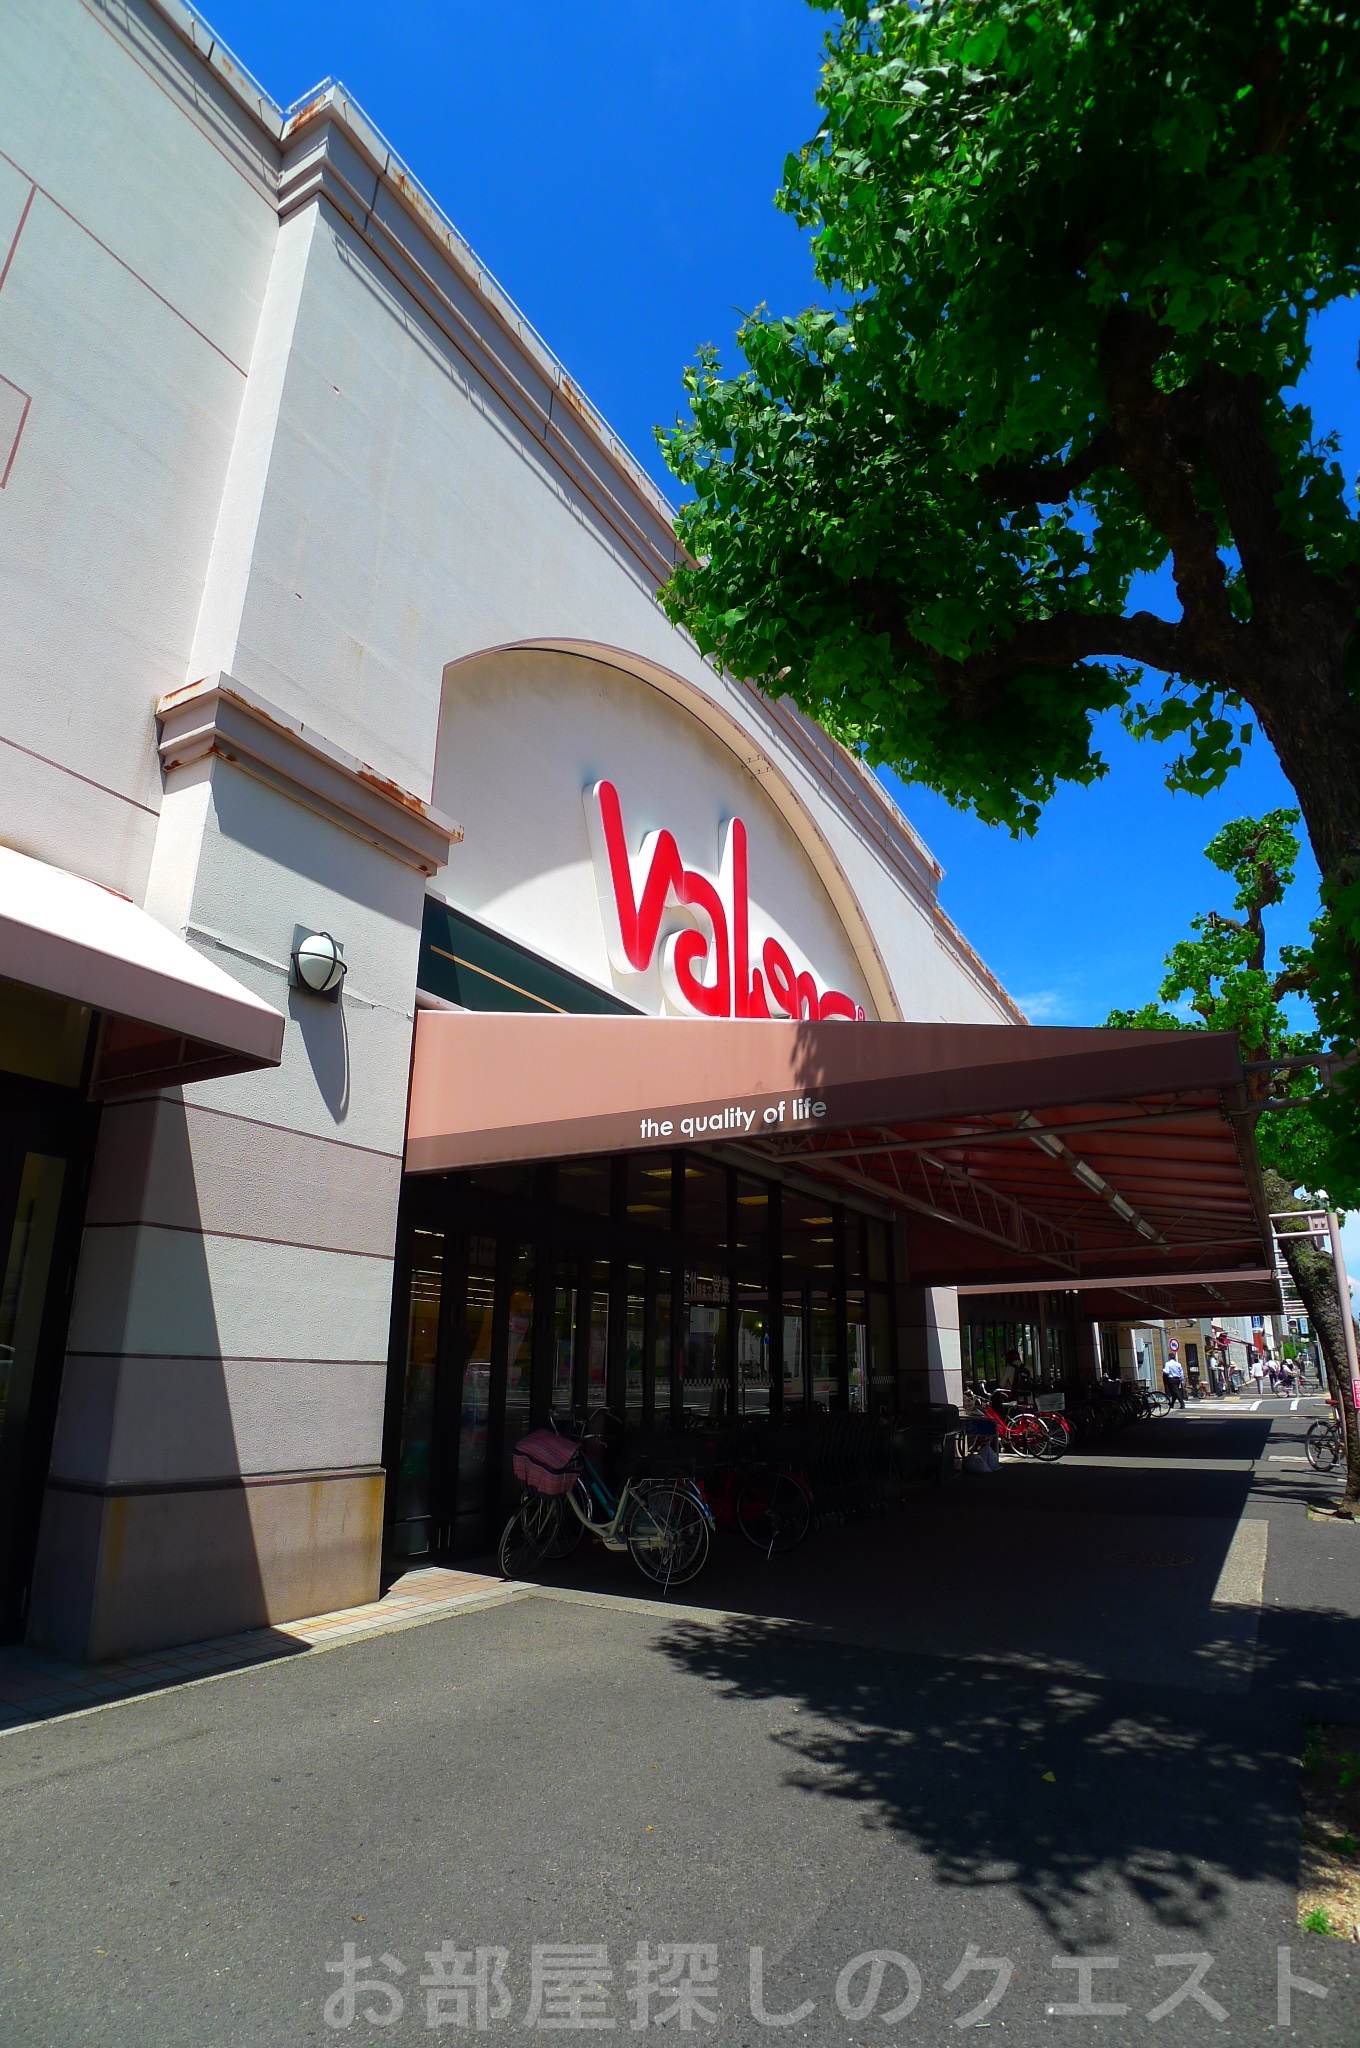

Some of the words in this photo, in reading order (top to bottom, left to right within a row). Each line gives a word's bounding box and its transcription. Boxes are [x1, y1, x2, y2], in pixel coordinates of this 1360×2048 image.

[640, 1118, 674, 1139] the
[680, 1106, 756, 1138] quality
[763, 1100, 786, 1124] of
[792, 1097, 827, 1121] life
